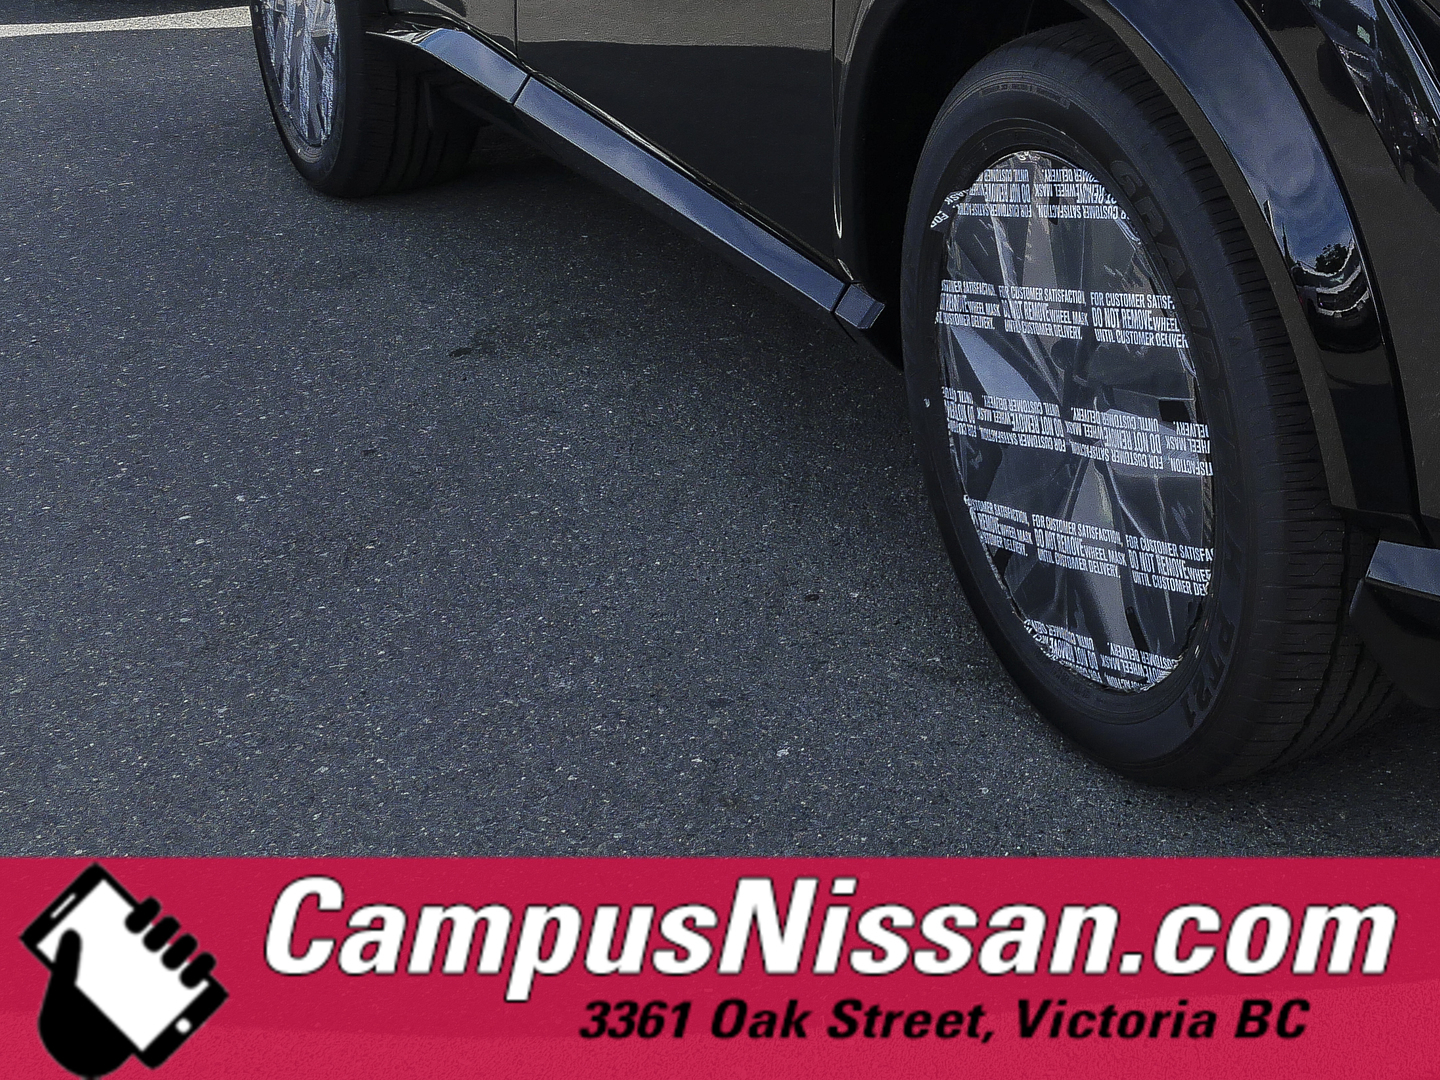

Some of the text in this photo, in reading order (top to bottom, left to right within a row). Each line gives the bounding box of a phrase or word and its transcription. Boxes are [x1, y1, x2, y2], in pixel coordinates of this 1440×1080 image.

[1082, 205, 1119, 220] CUSTOMER
[1090, 291, 1105, 307] FOR
[1105, 292, 1146, 309] CUSTOMER
[1091, 306, 1181, 333] DO NOT REMOVE WHEEL
[1094, 328, 1116, 343] UNTIL
[1115, 329, 1155, 347] CUSTOMER
[1132, 431, 1150, 453] NOT
[1149, 433, 1163, 455] DO
[1110, 449, 1149, 469] CUSTOMER
[1149, 454, 1164, 470] FOR
[1125, 534, 1141, 551] FOR
[1139, 536, 1180, 559] CUSTOMER
[1128, 549, 1140, 571] DO
[1138, 552, 1157, 574] NOT
[1151, 574, 1194, 596] CUSTOMER
